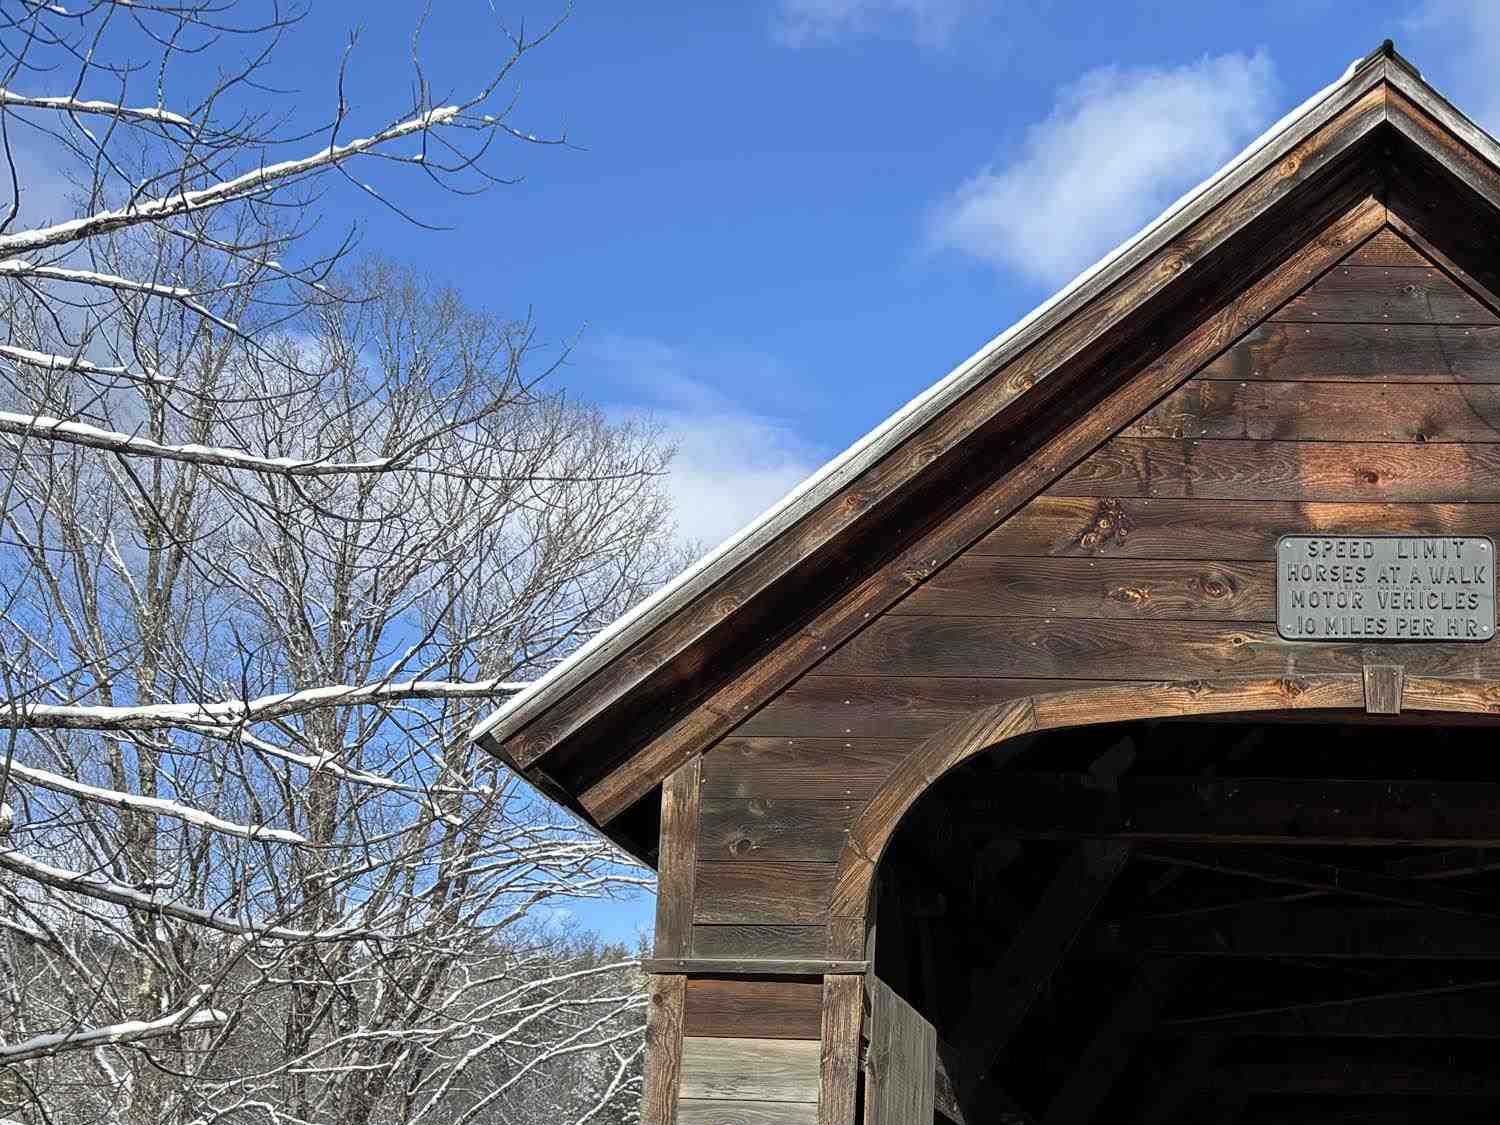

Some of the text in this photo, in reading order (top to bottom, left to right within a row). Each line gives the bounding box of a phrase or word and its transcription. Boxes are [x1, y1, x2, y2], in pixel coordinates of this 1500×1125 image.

[1307, 540, 1465, 559] SPEED LIMIT
[1287, 563, 1487, 585] HORSES AT A WALK
[1291, 591, 1480, 611] MOTOR VEHICLES
[1298, 615, 1316, 635] 10
[1324, 617, 1388, 635] MILES
[1396, 618, 1434, 636] PER
